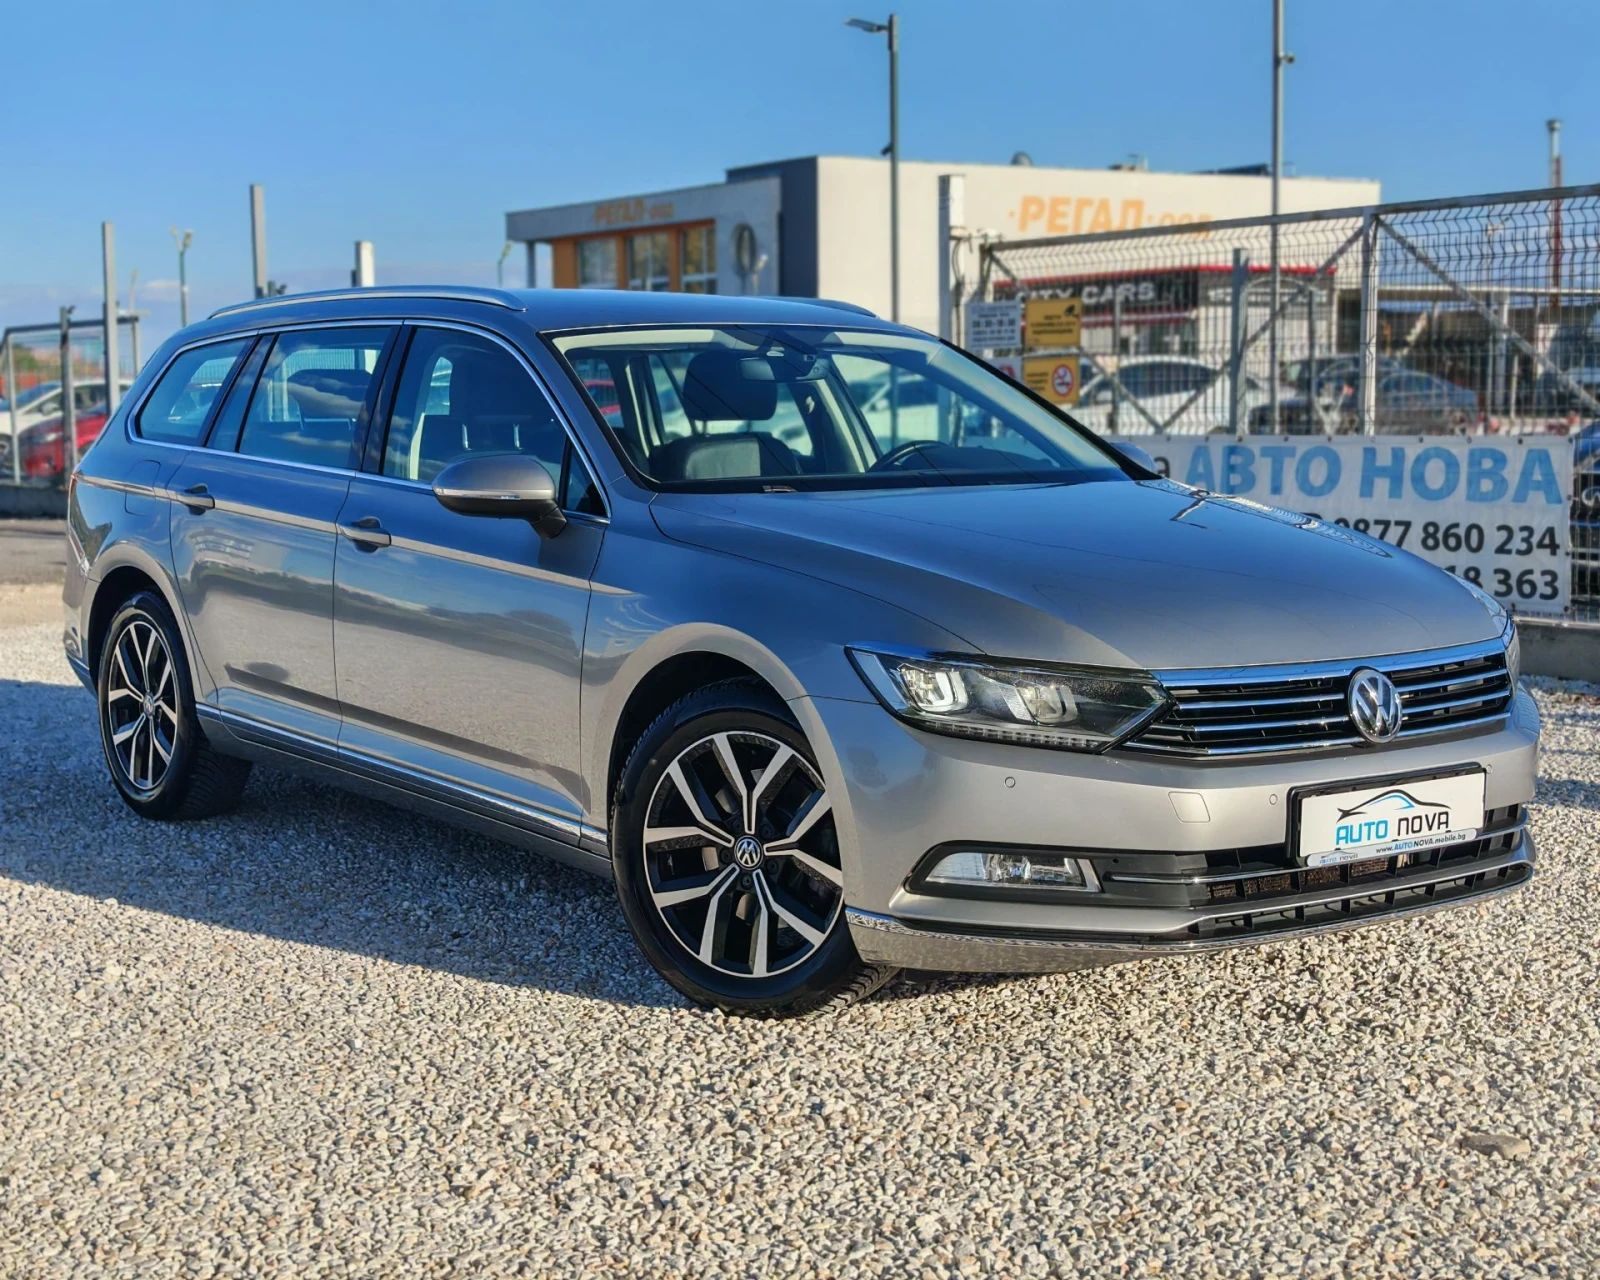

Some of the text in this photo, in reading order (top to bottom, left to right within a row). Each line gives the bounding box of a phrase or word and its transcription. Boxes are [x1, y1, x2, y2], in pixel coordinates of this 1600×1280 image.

[1018, 196, 1145, 233] РЕГАЛ
[1081, 281, 1156, 305] CARS
[1185, 445, 1342, 497] АВТО
[1359, 446, 1563, 504] НОВА
[1334, 517, 1560, 556] 877 860 234
[1493, 567, 1560, 600] 363
[1335, 811, 1450, 845] AUTO NOVA
